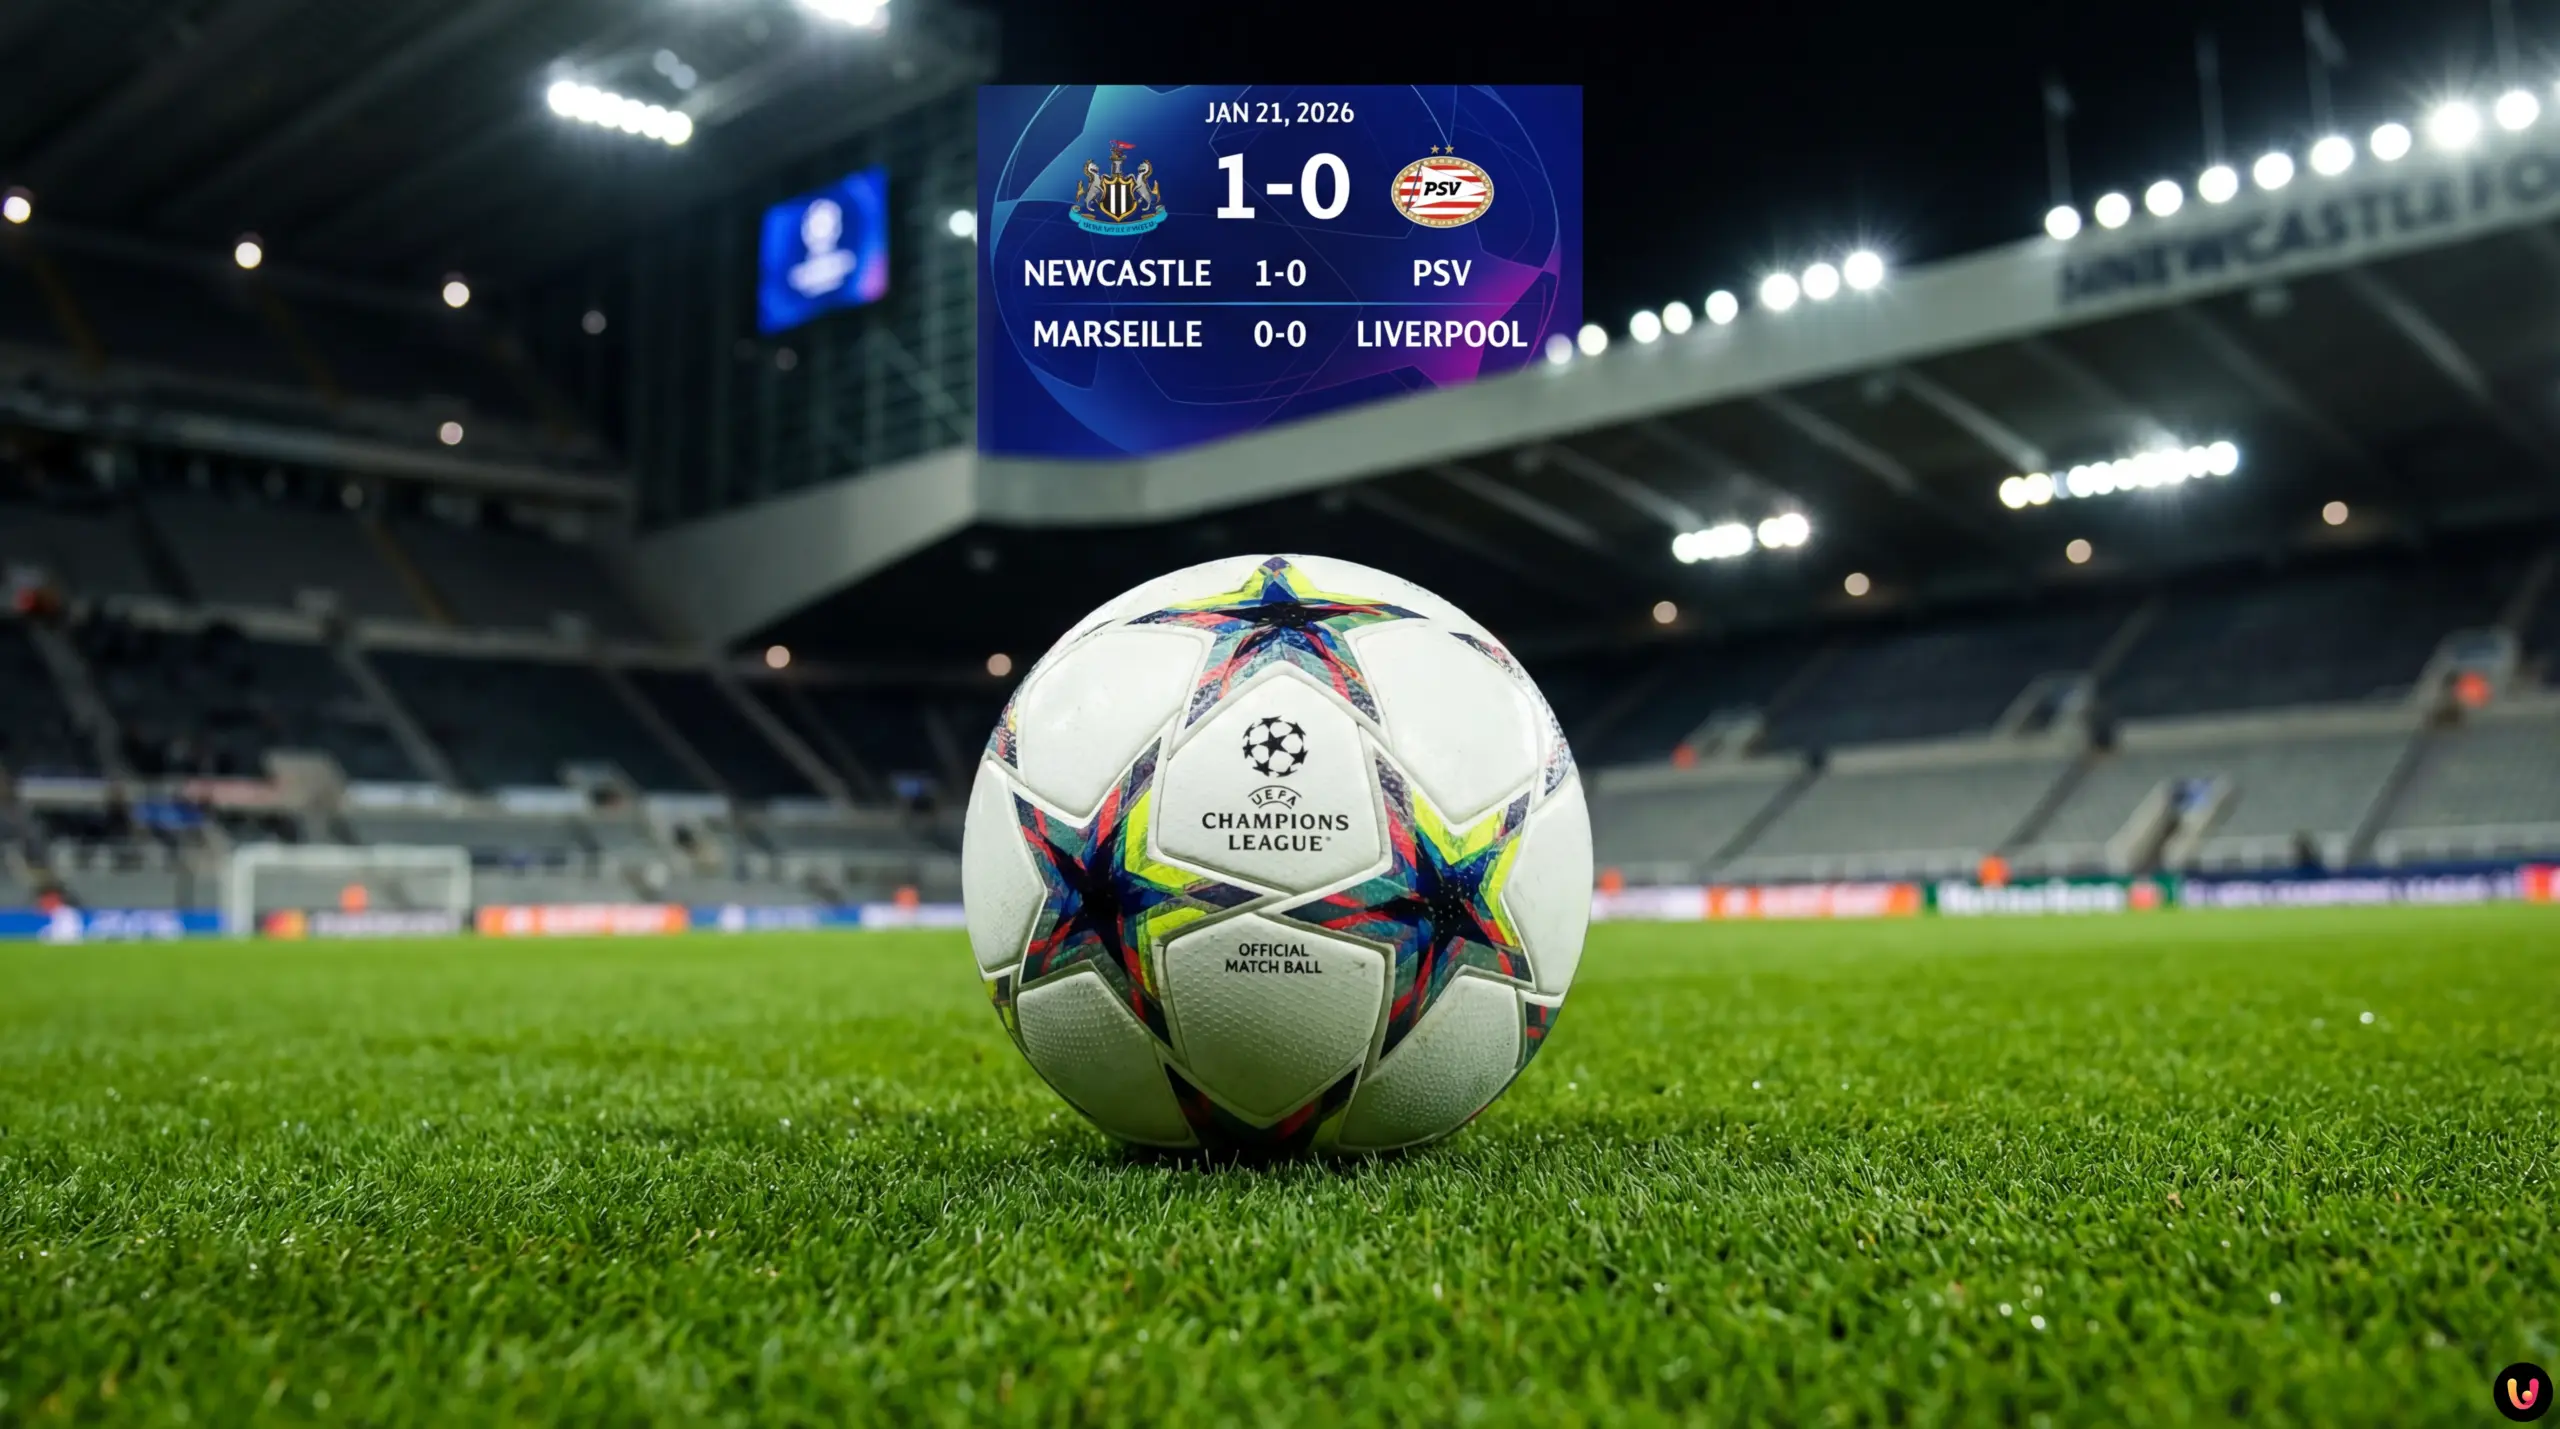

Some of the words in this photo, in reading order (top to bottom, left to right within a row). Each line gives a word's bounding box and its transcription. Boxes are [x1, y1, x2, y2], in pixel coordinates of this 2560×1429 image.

[1205, 102, 1249, 123] JAN
[1256, 102, 1291, 127] 21,
[1297, 102, 1355, 123] 2026
[1216, 152, 1351, 220] 1-0
[1423, 181, 1462, 196] PSV
[1024, 259, 1212, 287] NEWCASTLE
[1255, 259, 1307, 287] 1-0
[1414, 259, 1472, 287] PSV
[1034, 320, 1203, 348] MARSEILLE
[1254, 320, 1307, 348] 0-0
[1357, 320, 1528, 348] LIVERPOOL
[1251, 789, 1297, 806] UEFA
[1202, 812, 1349, 831] CHAMPIONS
[1238, 943, 1310, 958] OFFICIAL
[1224, 958, 1280, 974] MATCH
[1284, 960, 1323, 974] BALL
